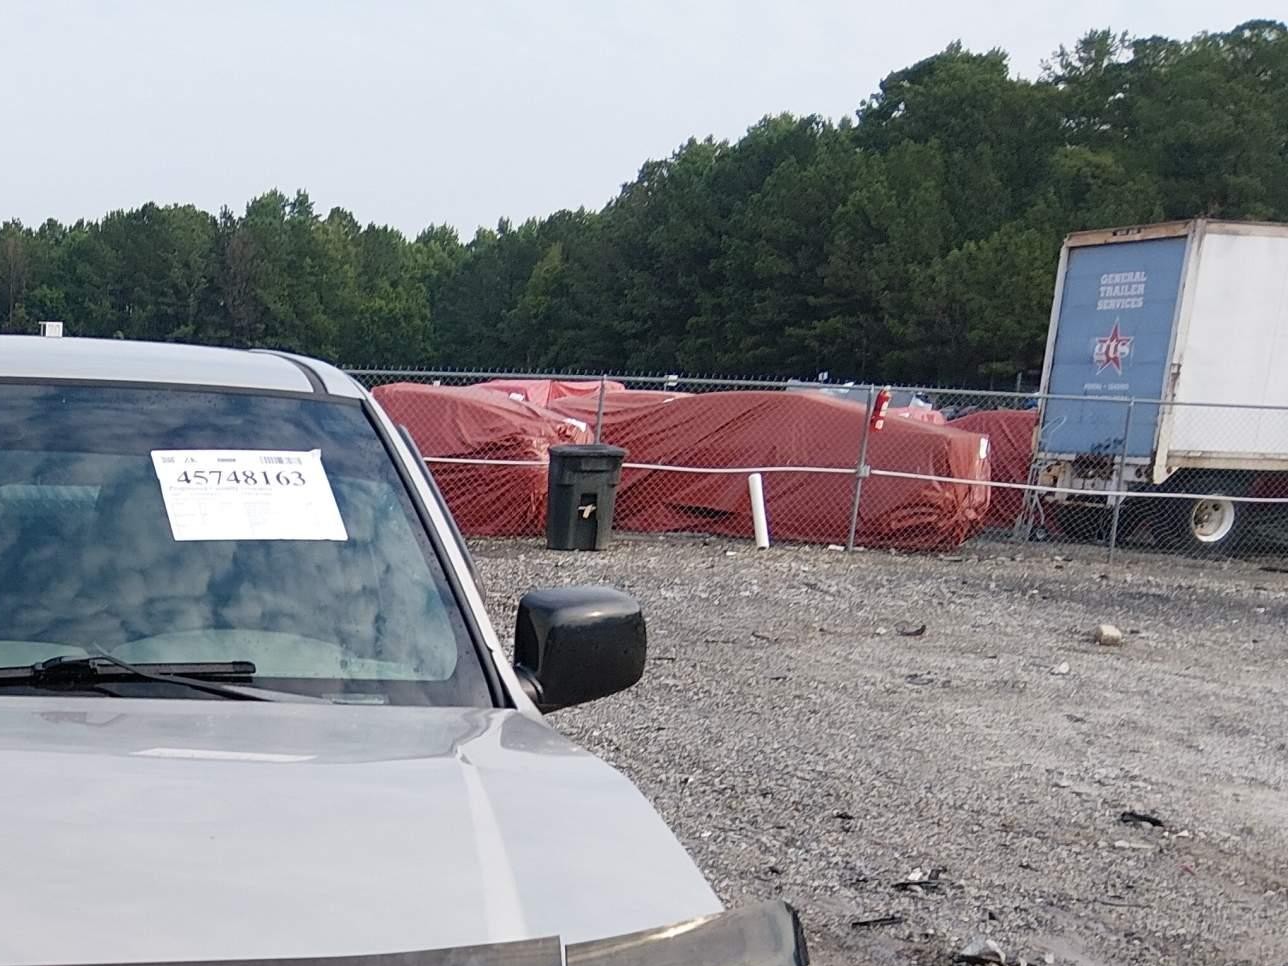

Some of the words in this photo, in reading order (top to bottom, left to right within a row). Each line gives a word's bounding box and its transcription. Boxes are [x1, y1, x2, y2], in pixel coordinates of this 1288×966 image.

[1100, 271, 1147, 285] GENERAL
[1099, 284, 1145, 297] TRAILER
[1097, 297, 1144, 310] SERVICES
[177, 470, 306, 487] 45748163
